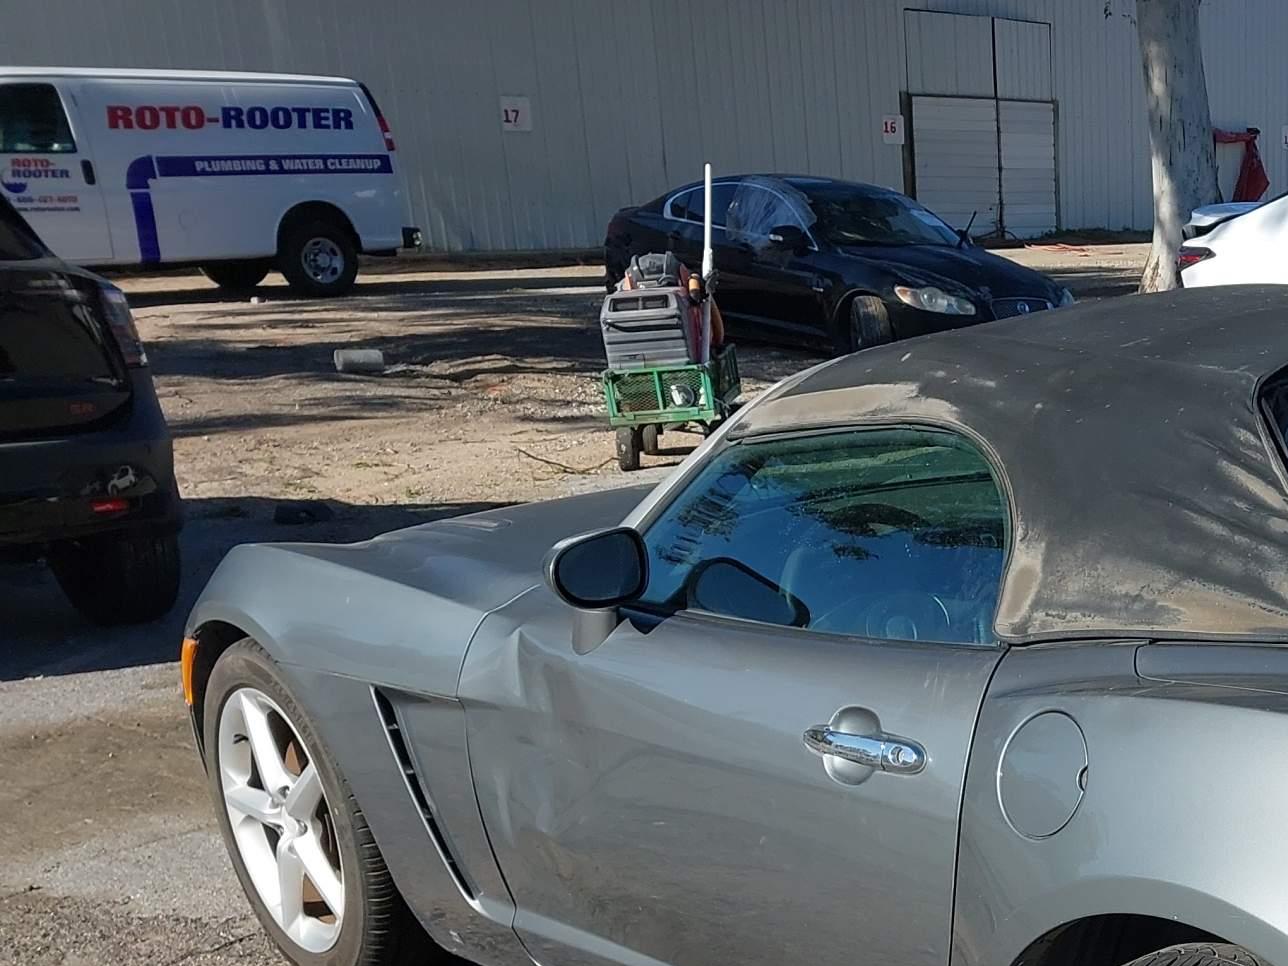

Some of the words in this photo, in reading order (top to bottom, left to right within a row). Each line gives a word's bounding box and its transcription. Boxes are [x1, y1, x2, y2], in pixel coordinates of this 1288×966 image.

[106, 105, 354, 130] ROTO-ROOTER
[503, 108, 520, 124] 17
[883, 120, 897, 134] 16
[10, 158, 55, 168] ROTO-
[195, 160, 266, 171] PLUMBING
[268, 160, 279, 170] &
[281, 159, 324, 170] WATER
[326, 158, 382, 170] CLEANUP
[11, 169, 71, 178] ROOTER
